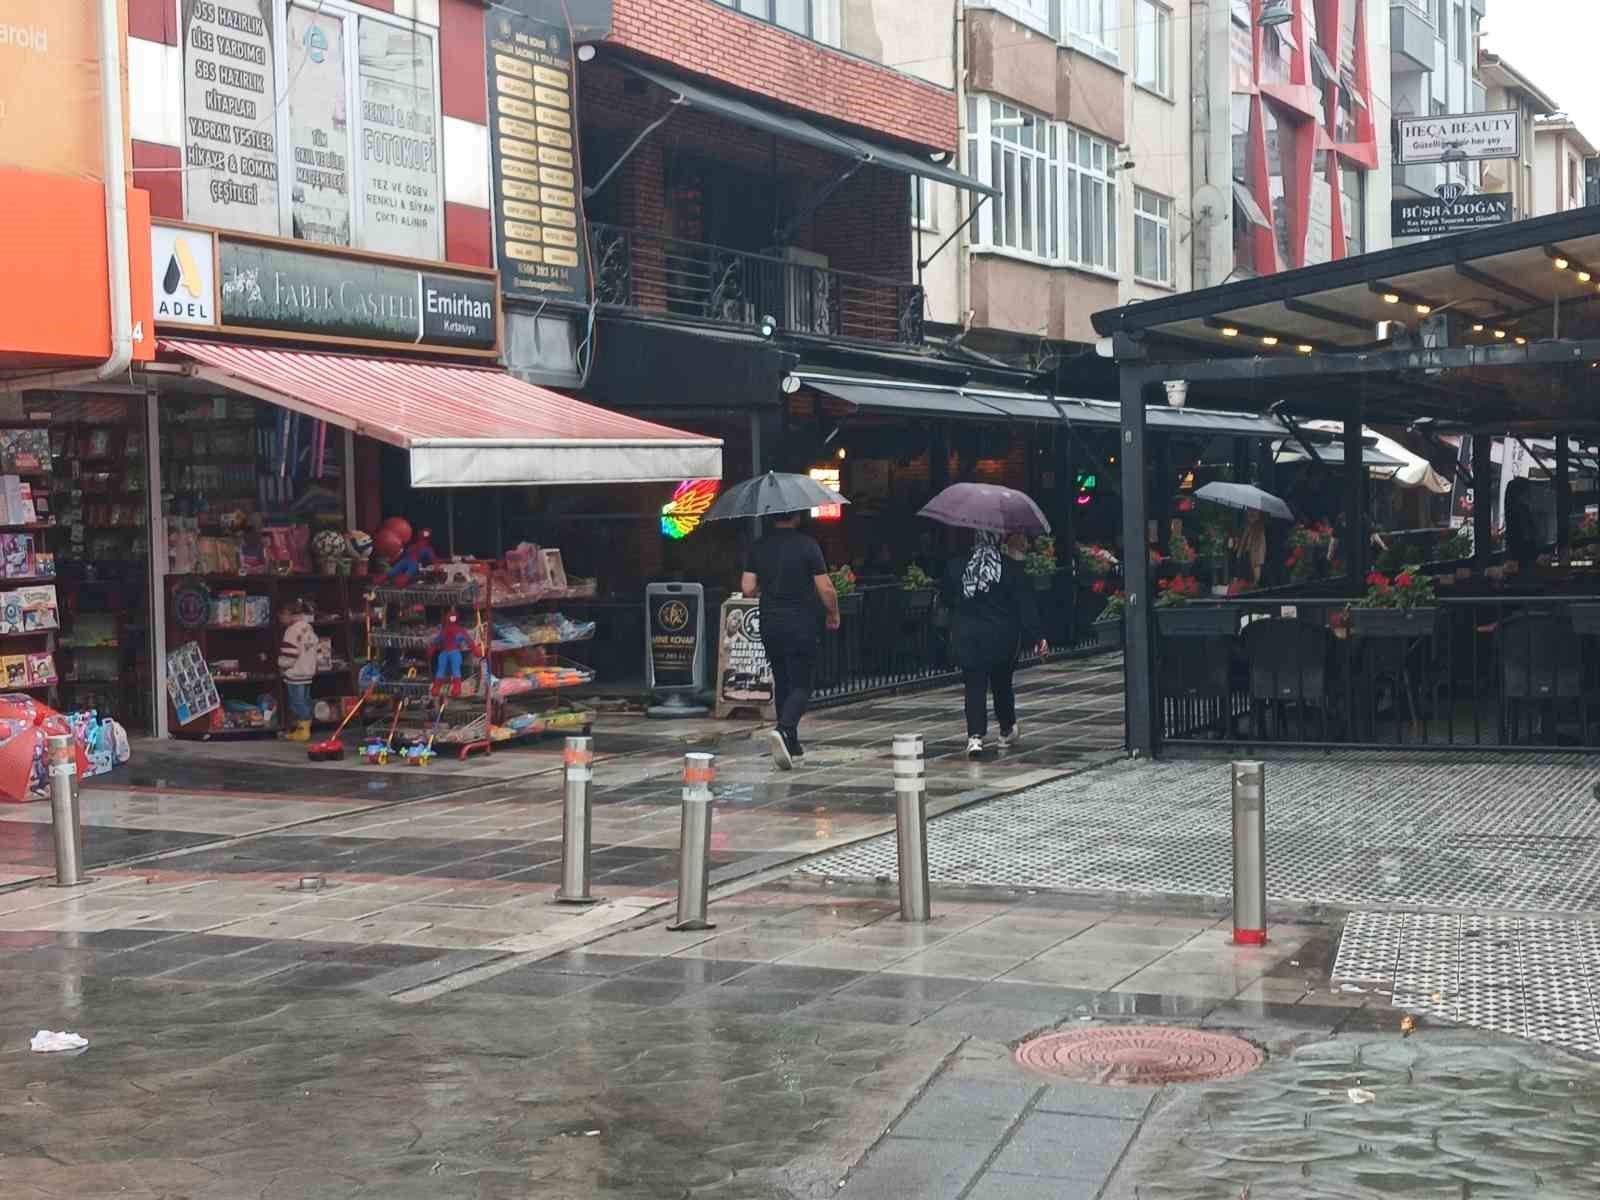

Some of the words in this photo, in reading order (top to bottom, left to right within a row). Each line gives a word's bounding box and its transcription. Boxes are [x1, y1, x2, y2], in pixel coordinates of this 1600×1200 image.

[217, 6, 264, 37] HAZIRLIK
[192, 26, 214, 52] LİSE
[195, 59, 217, 81] SBS
[218, 65, 265, 94] HAZIRLIK
[205, 88, 257, 120] KİTAPLARI
[188, 115, 231, 143] YAPRAK
[1405, 124, 1448, 138] HEÇA
[1451, 119, 1513, 134] BEAUTY
[363, 127, 438, 175] FOTOKOPİ
[209, 178, 258, 206] ÇEŞİTLERİ
[1453, 201, 1507, 215] DOĞAN
[159, 300, 208, 320] ADEL
[426, 288, 492, 320] Emirhan
